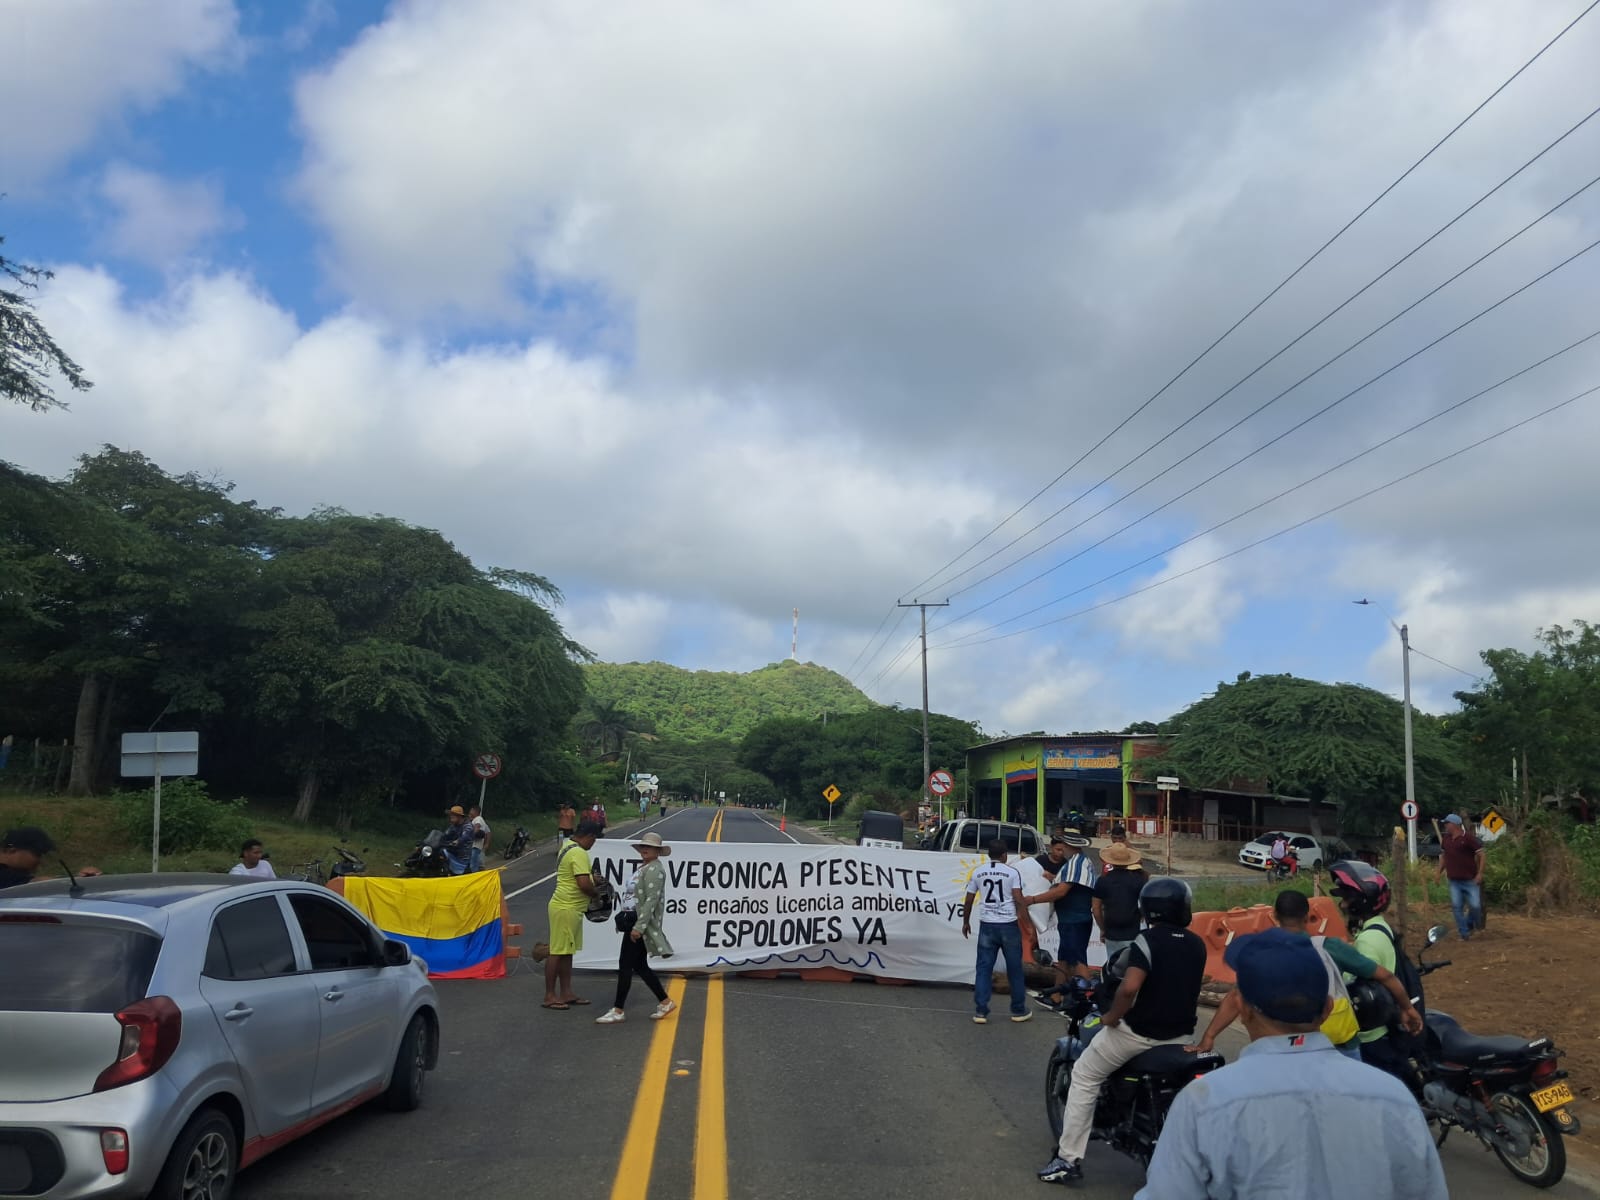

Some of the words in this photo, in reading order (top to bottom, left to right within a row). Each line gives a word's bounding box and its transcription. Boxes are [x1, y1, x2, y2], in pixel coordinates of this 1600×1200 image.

[1047, 758, 1074, 768] SANTA
[1078, 757, 1118, 768] VERONICA
[668, 860, 788, 889] VERONICA
[697, 896, 769, 914] engaños
[776, 893, 844, 914] licencia
[851, 893, 940, 914] ambiental
[983, 878, 1005, 904] 21
[704, 916, 842, 948] ESPOLONES
[852, 916, 888, 946] YA
